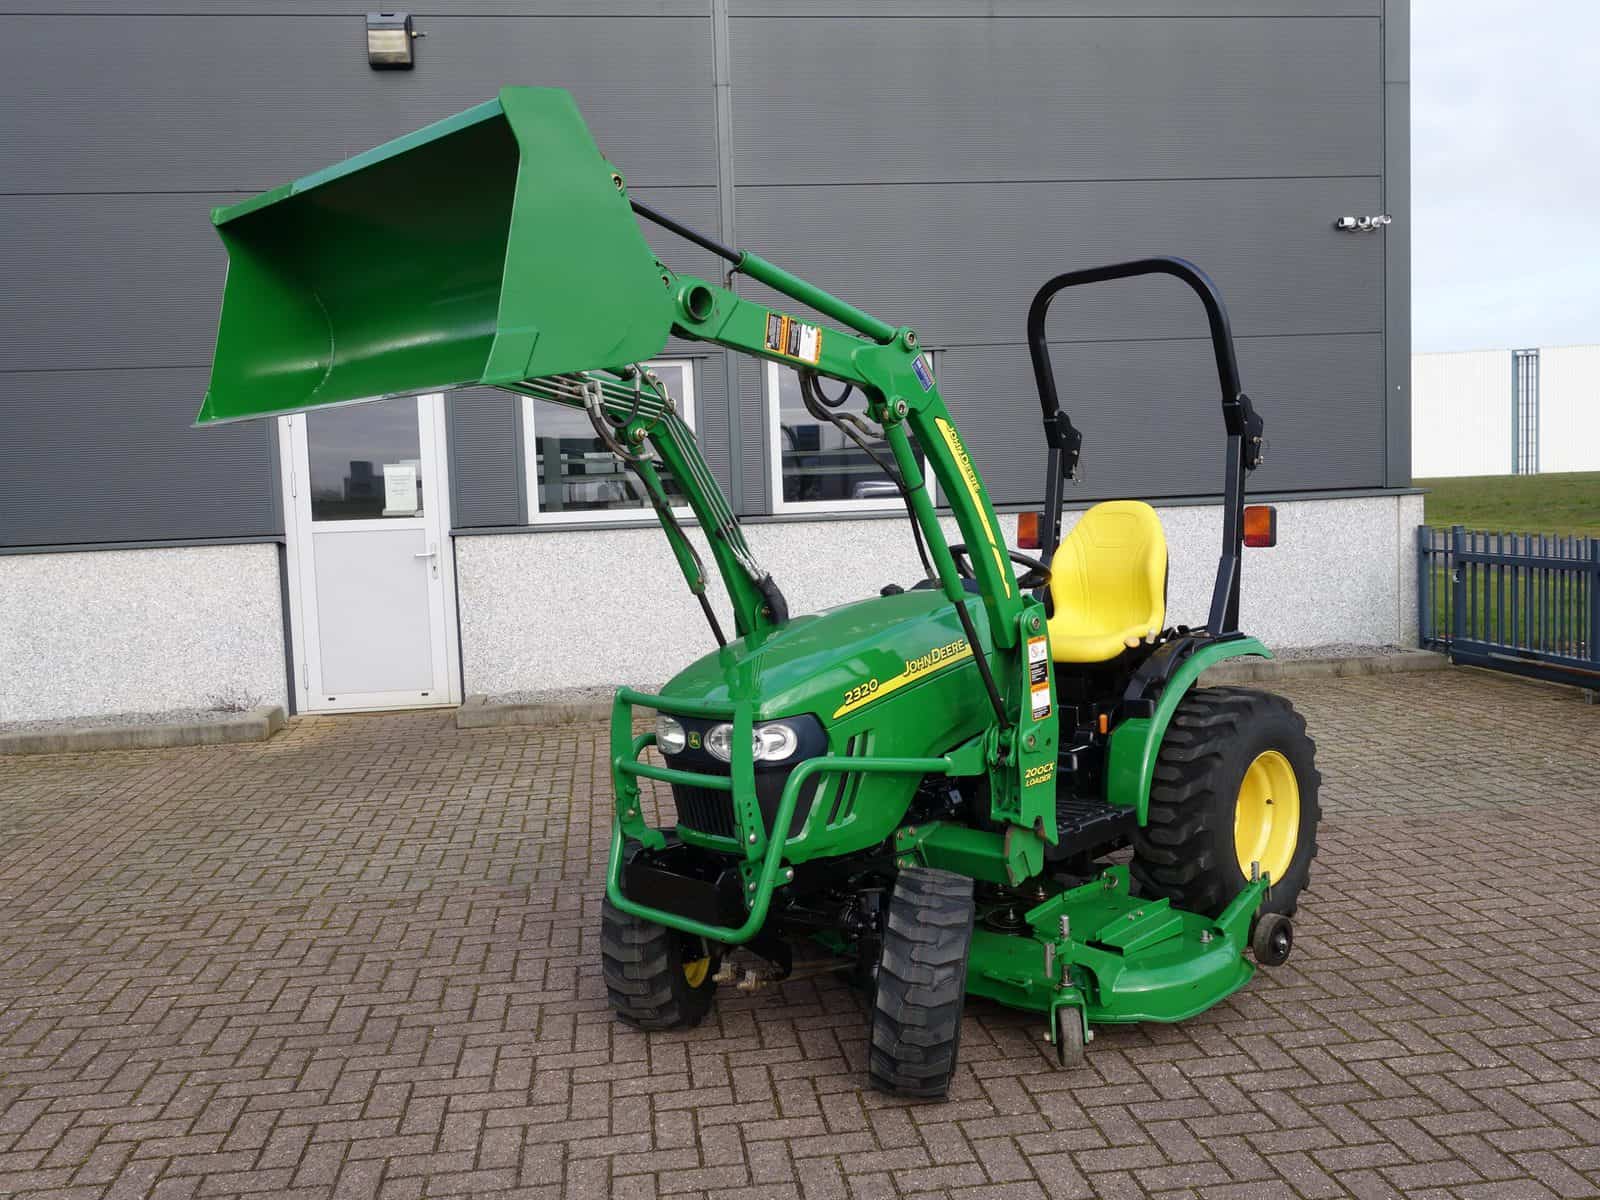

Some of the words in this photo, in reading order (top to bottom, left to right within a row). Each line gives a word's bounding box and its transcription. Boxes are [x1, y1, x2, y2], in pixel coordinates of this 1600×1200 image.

[844, 678, 879, 705] 2320
[1024, 761, 1055, 779] 200CX
[1025, 773, 1052, 788] LOADER
